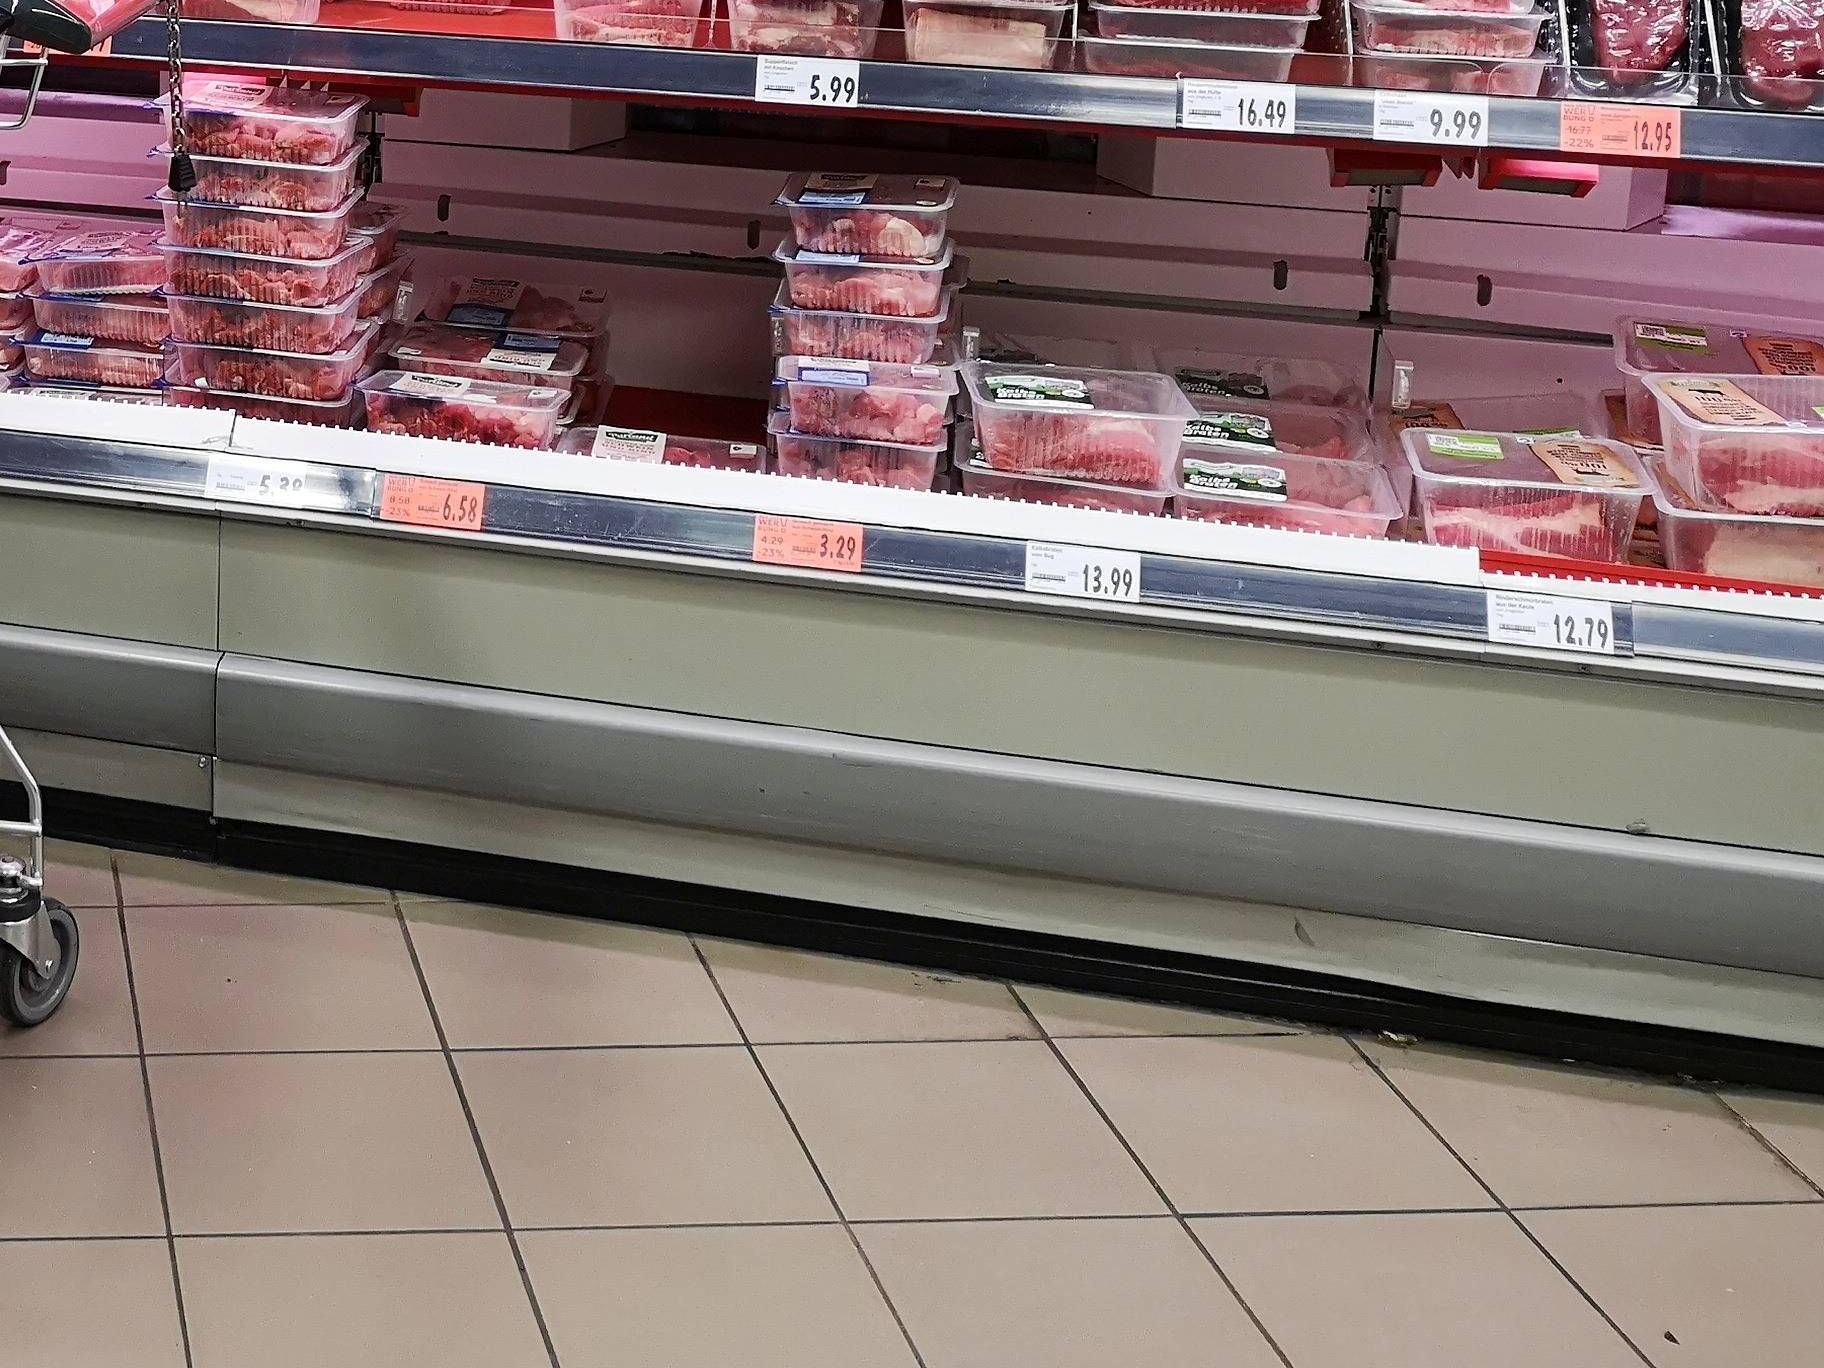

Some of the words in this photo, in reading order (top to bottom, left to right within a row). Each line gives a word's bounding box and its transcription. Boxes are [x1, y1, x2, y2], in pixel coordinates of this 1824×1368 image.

[808, 74, 857, 104] 5.99
[1235, 95, 1288, 129] 16.49
[1429, 108, 1482, 141] 9.99
[1562, 137, 1595, 149] -22%
[1631, 119, 1674, 153] 12.95
[441, 492, 478, 524] 6.58
[818, 535, 857, 564] 3.29
[1081, 564, 1133, 598] 13.99
[1552, 613, 1610, 650] 12.79
